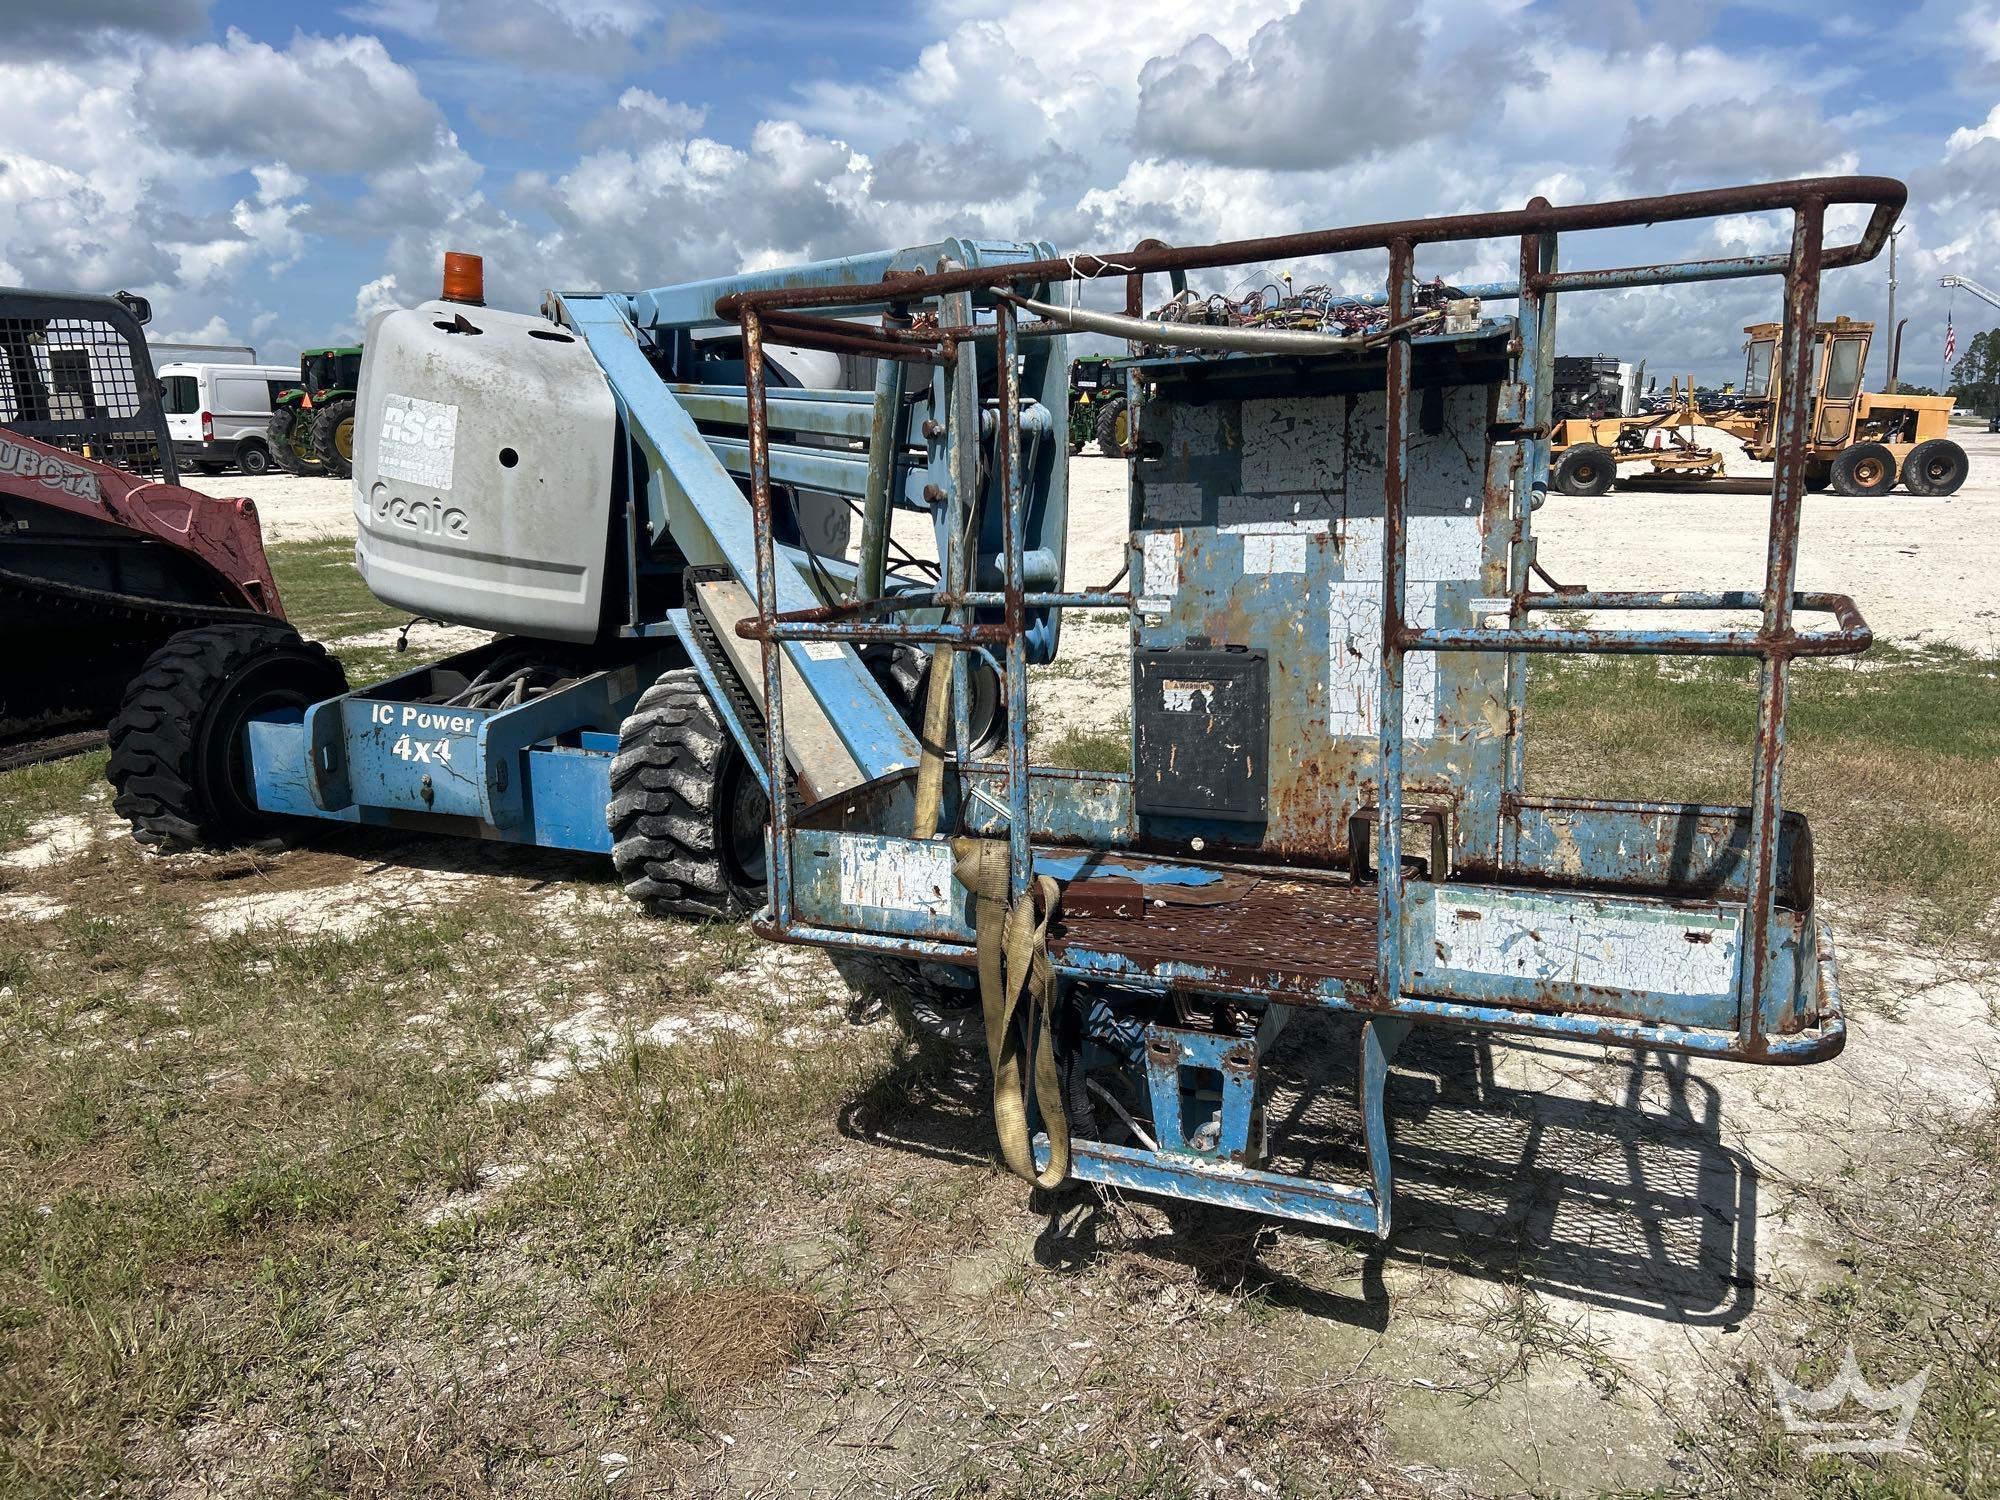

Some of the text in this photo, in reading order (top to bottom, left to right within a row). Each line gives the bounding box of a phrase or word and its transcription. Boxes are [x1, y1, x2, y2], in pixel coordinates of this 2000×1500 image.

[0, 439, 100, 503] UBOTA
[371, 481, 469, 541] Genie
[1179, 682, 1211, 690] WARNING
[371, 703, 475, 733] IC Power
[392, 733, 452, 766] 4x4
